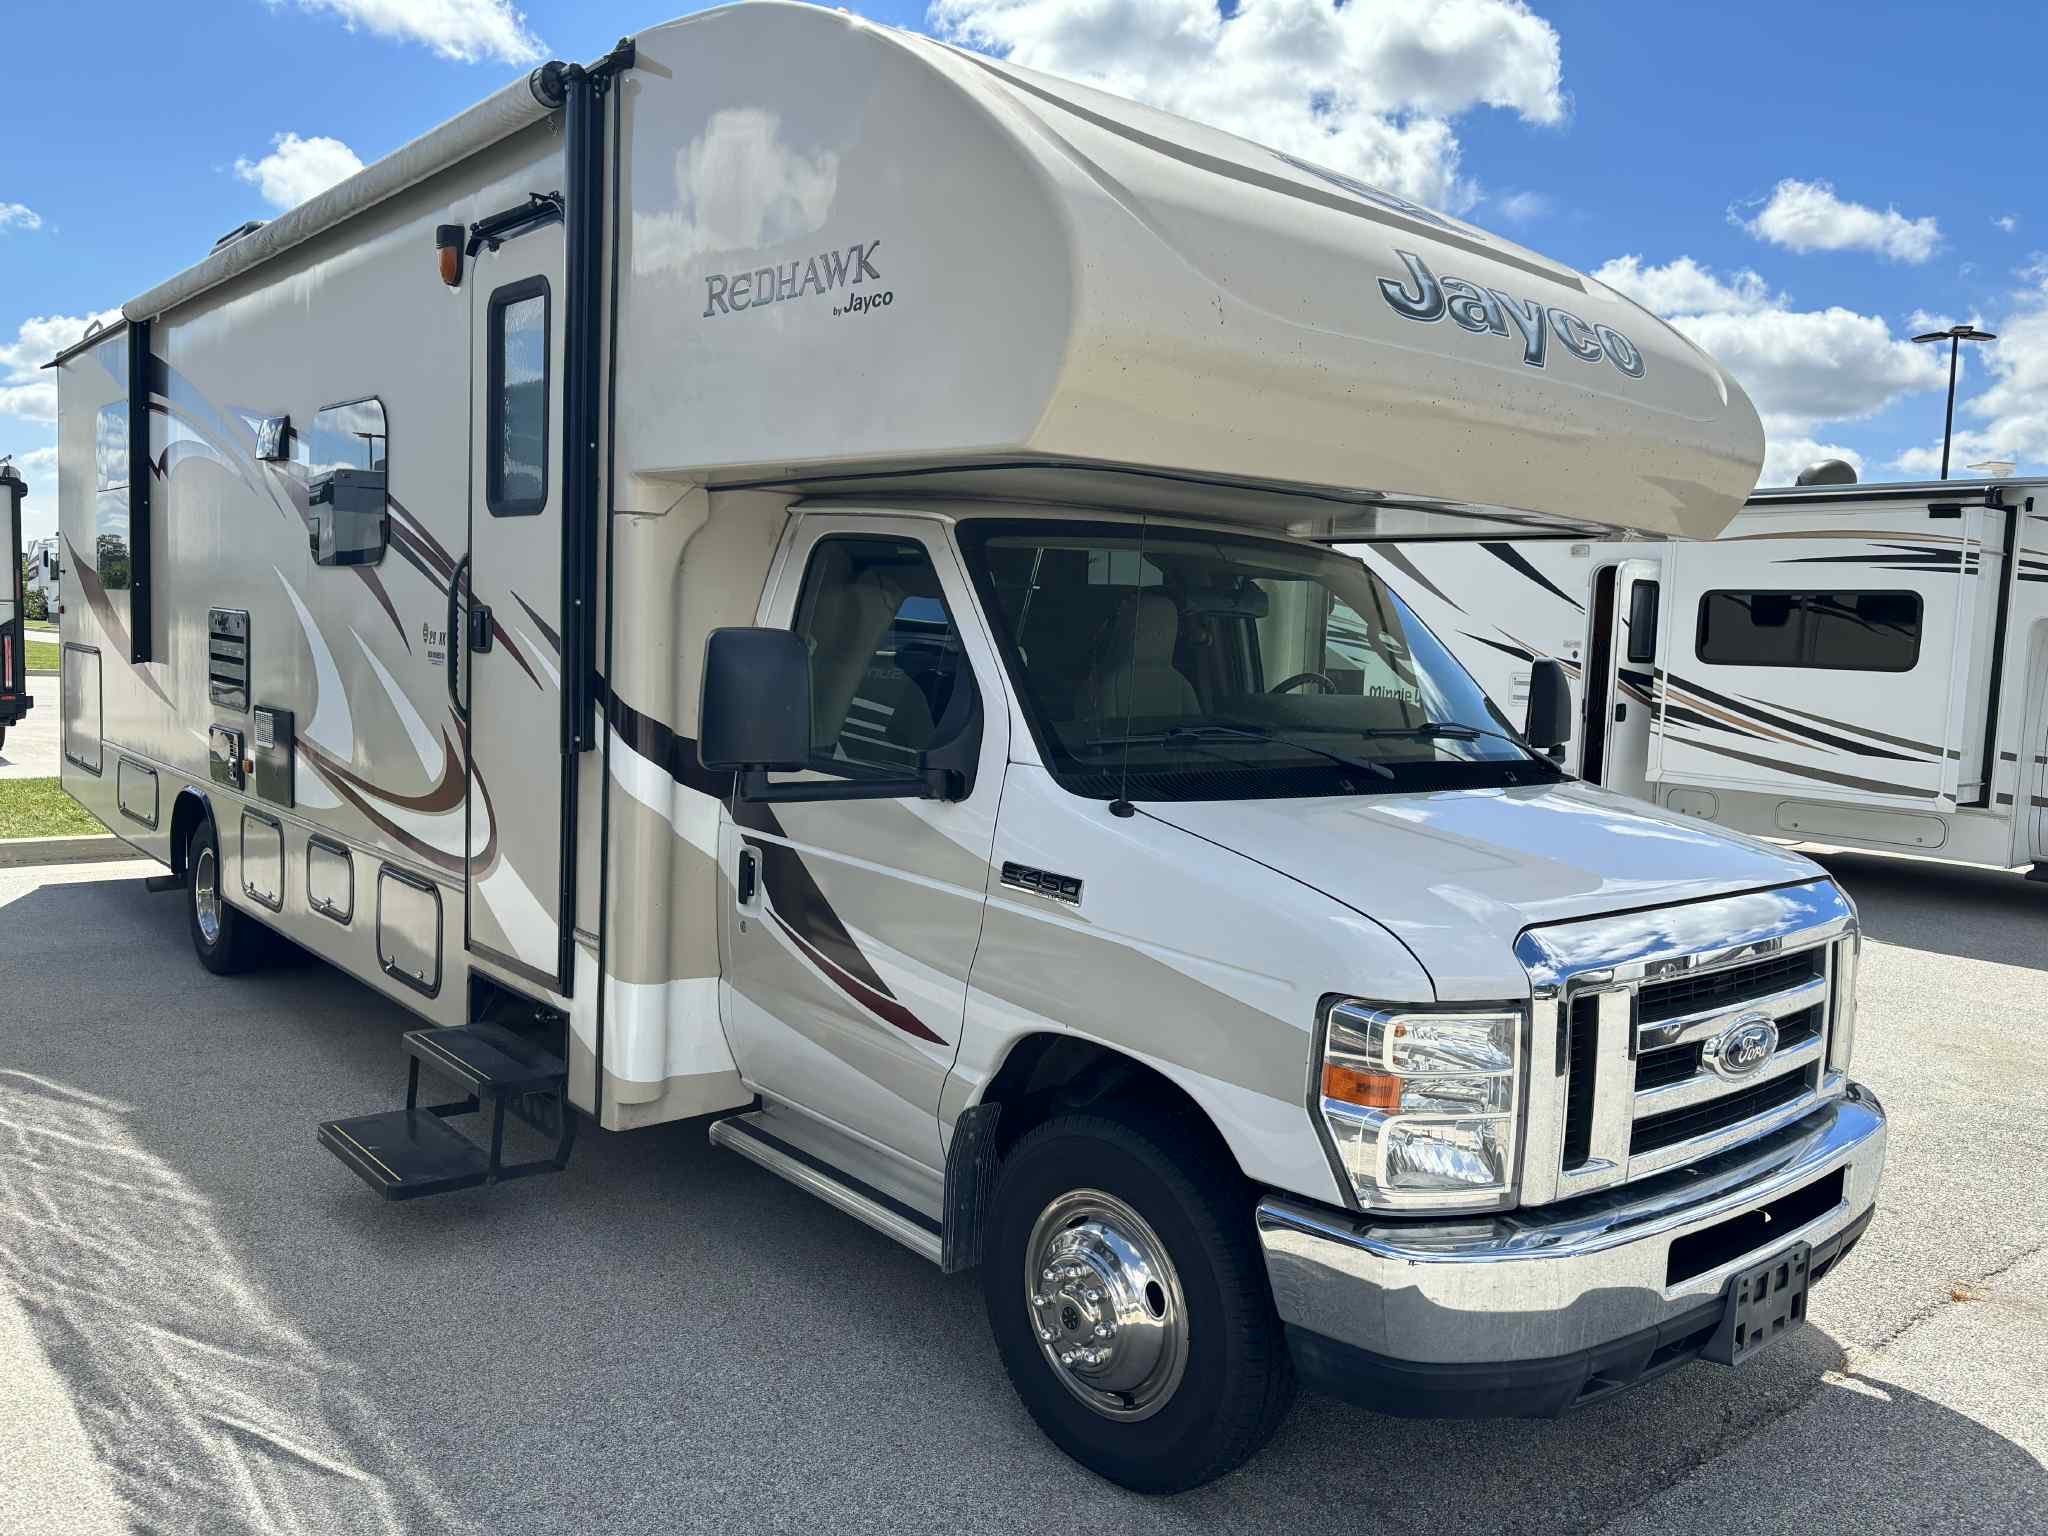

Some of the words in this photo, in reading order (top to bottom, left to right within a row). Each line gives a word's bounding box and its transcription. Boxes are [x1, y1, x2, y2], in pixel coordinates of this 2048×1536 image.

[703, 240, 881, 318] REDHAWK
[833, 306, 842, 317] by
[843, 291, 894, 314] Jayco
[1376, 248, 1647, 379] Jayco
[1738, 1033, 1768, 1064] Ford
